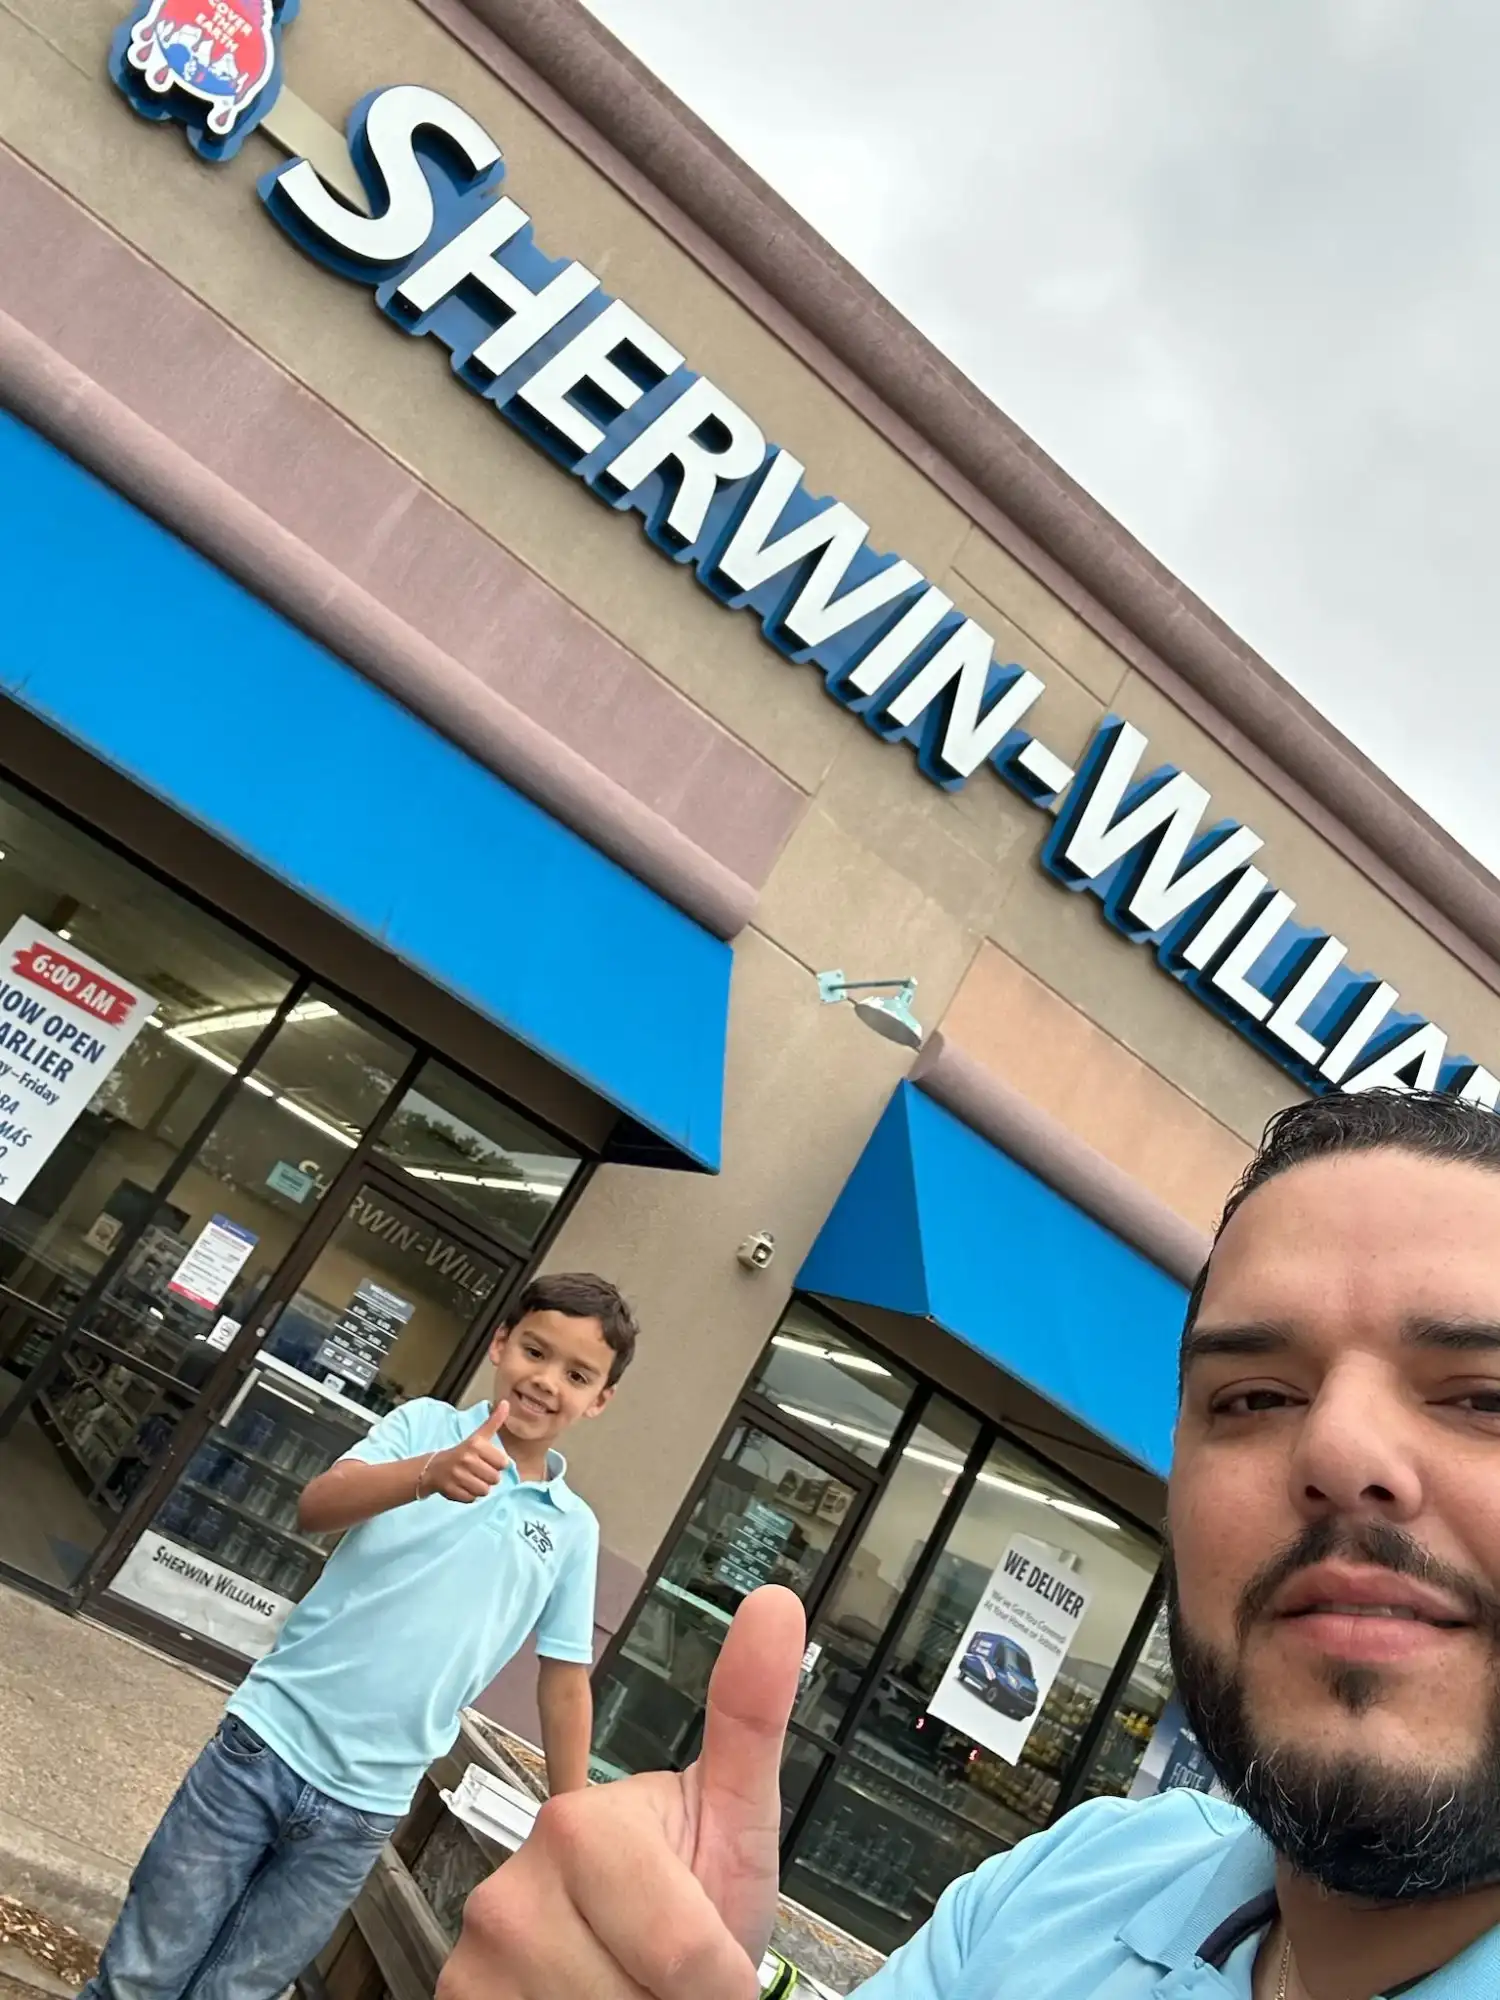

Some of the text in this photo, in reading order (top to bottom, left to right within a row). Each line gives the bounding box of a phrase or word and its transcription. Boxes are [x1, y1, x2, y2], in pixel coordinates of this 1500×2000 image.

[195, 13, 239, 52] EARTH
[212, 12, 239, 36] THE
[276, 84, 1500, 1113] SHERWIN-WILLIA
[32, 955, 116, 1016] 6:00 AM
[0, 980, 107, 1065] OW OPEN
[0, 1021, 74, 1083] ARLIER
[152, 1545, 276, 1618] SHERWIN WILLIAMS
[1003, 1550, 1085, 1619] WE DELIVER
